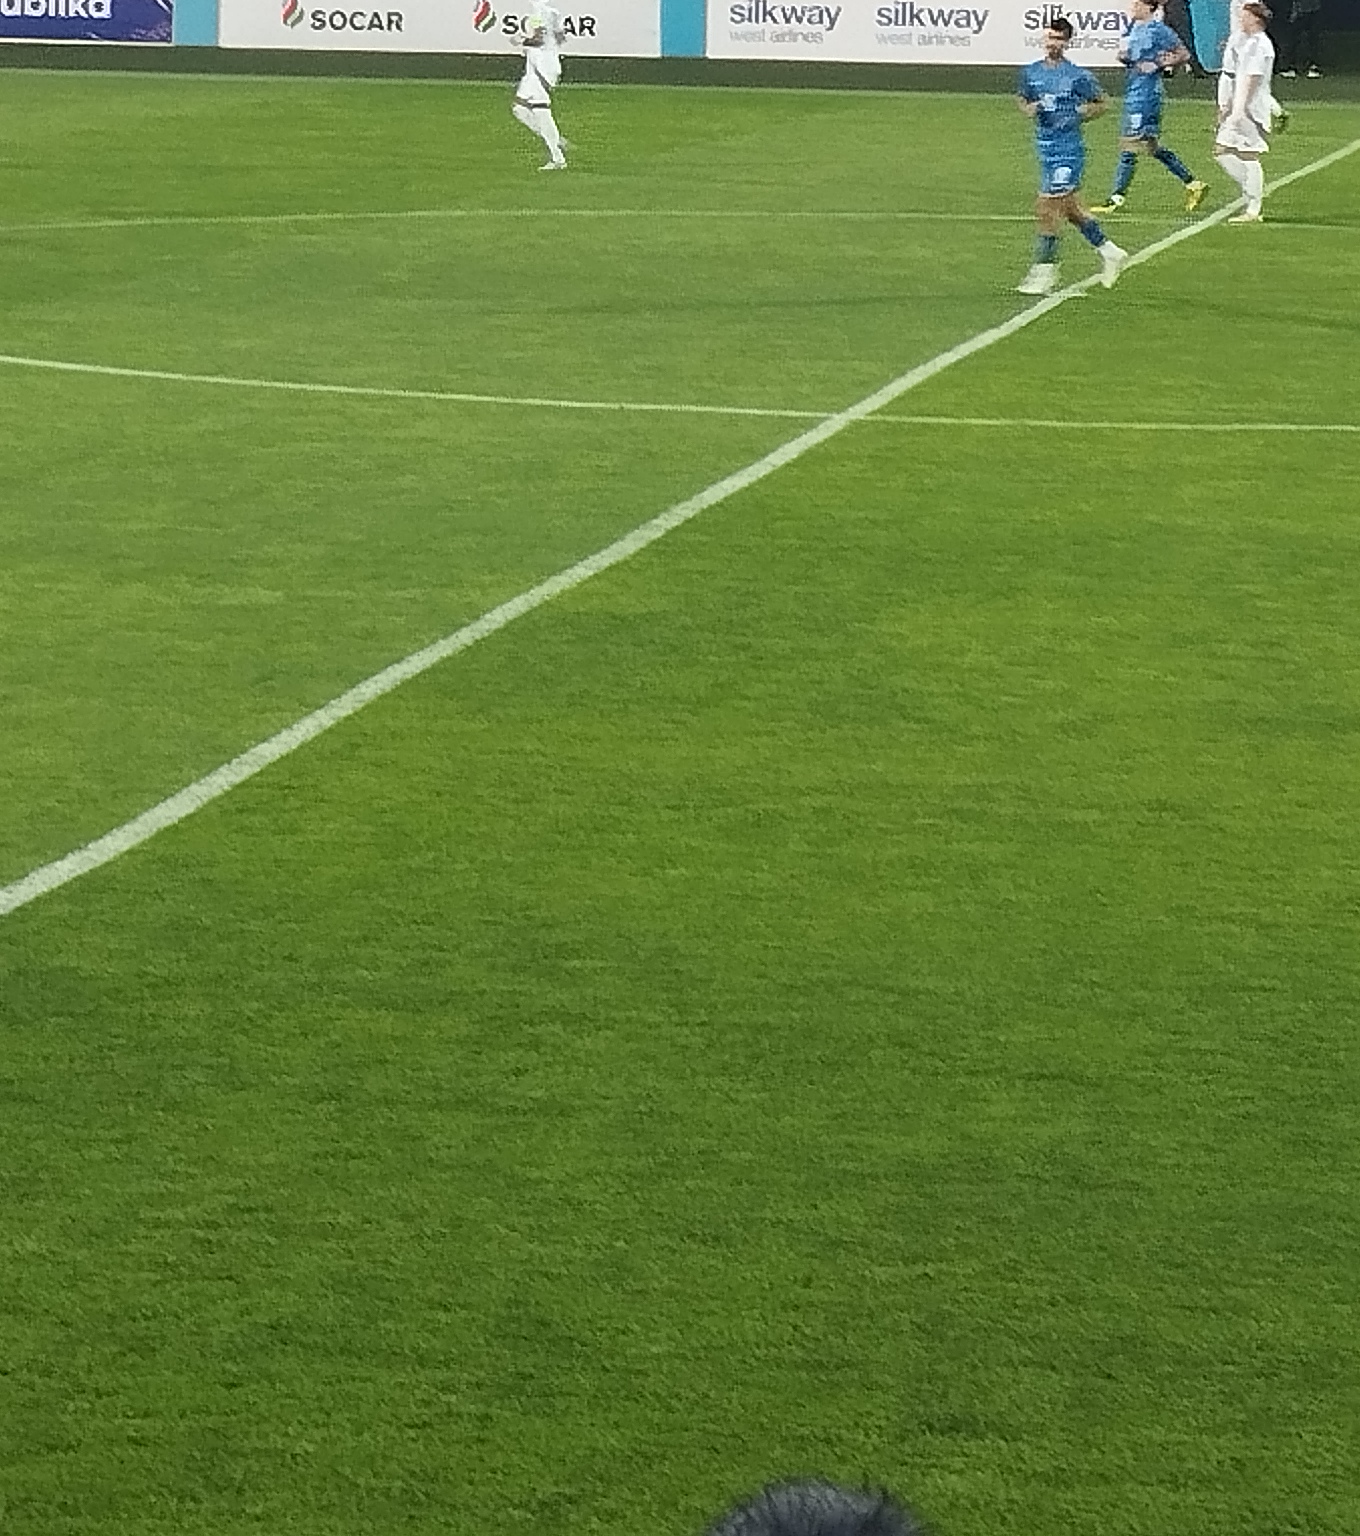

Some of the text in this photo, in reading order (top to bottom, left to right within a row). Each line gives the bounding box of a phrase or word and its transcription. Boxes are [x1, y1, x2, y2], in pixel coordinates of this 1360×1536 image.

[310, 9, 404, 31] SOCAR
[501, 14, 596, 37] SAR
[876, 0, 990, 34] silkway
